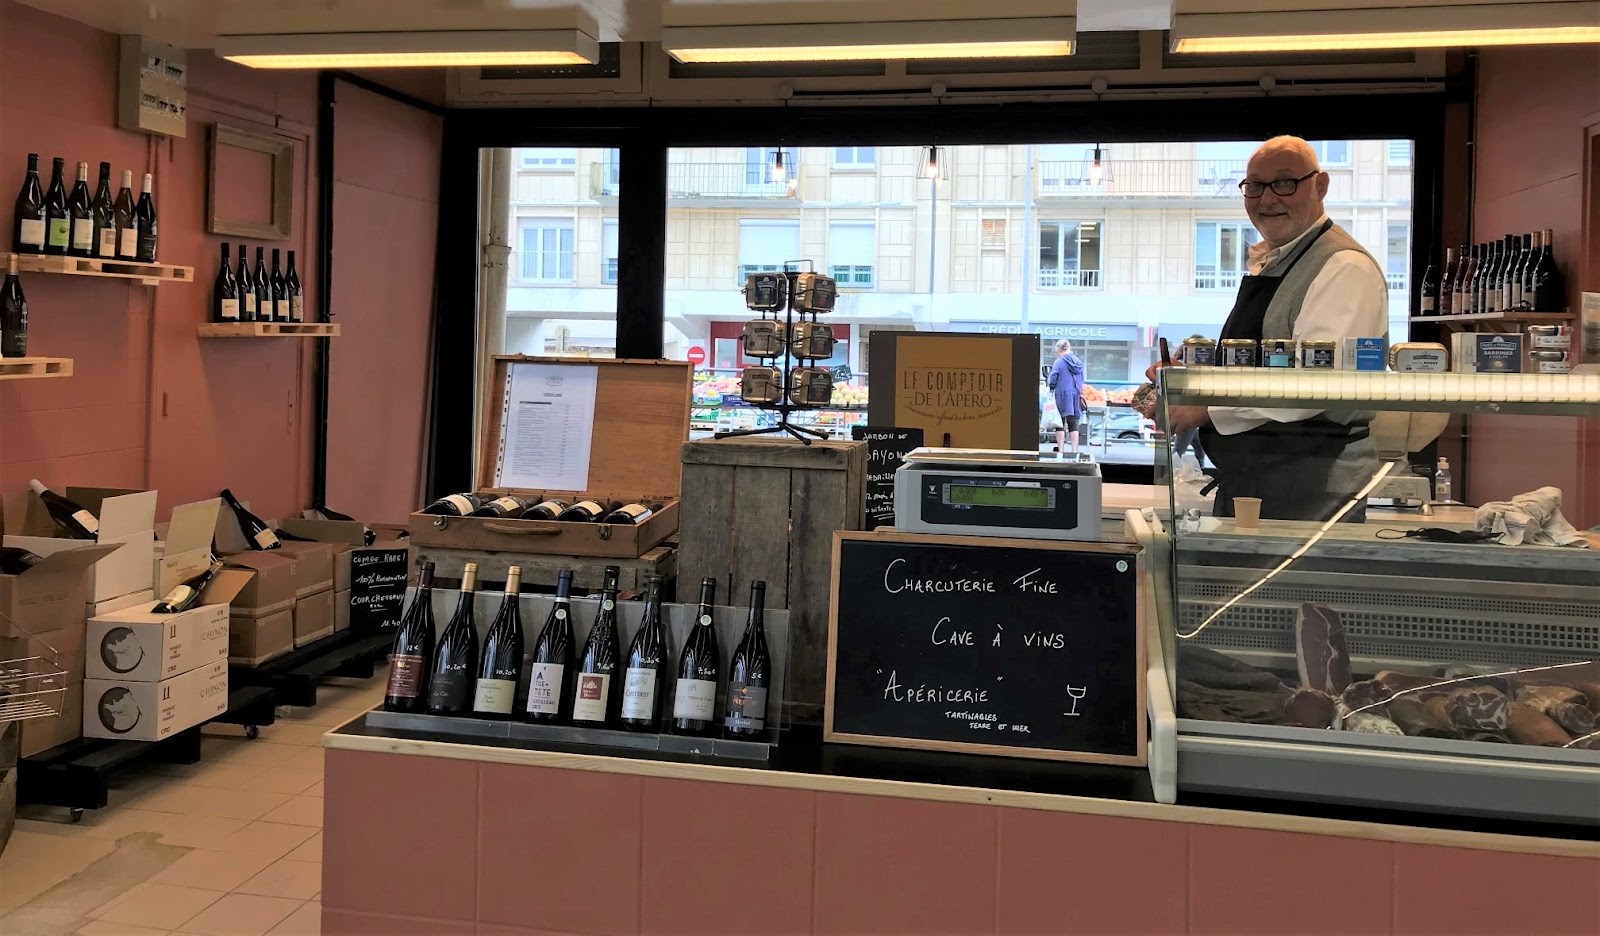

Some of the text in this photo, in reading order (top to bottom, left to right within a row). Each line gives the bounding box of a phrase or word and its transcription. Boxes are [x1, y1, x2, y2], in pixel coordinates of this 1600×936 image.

[1034, 326, 1107, 337] AGRICOLE
[904, 370, 1003, 392] LE COMPTOIR
[915, 390, 992, 408] DE L'APÉRO
[863, 432, 894, 441] JAMBON
[202, 627, 228, 640] CHINON
[992, 624, 1004, 646] À
[200, 681, 226, 698] CHINON
